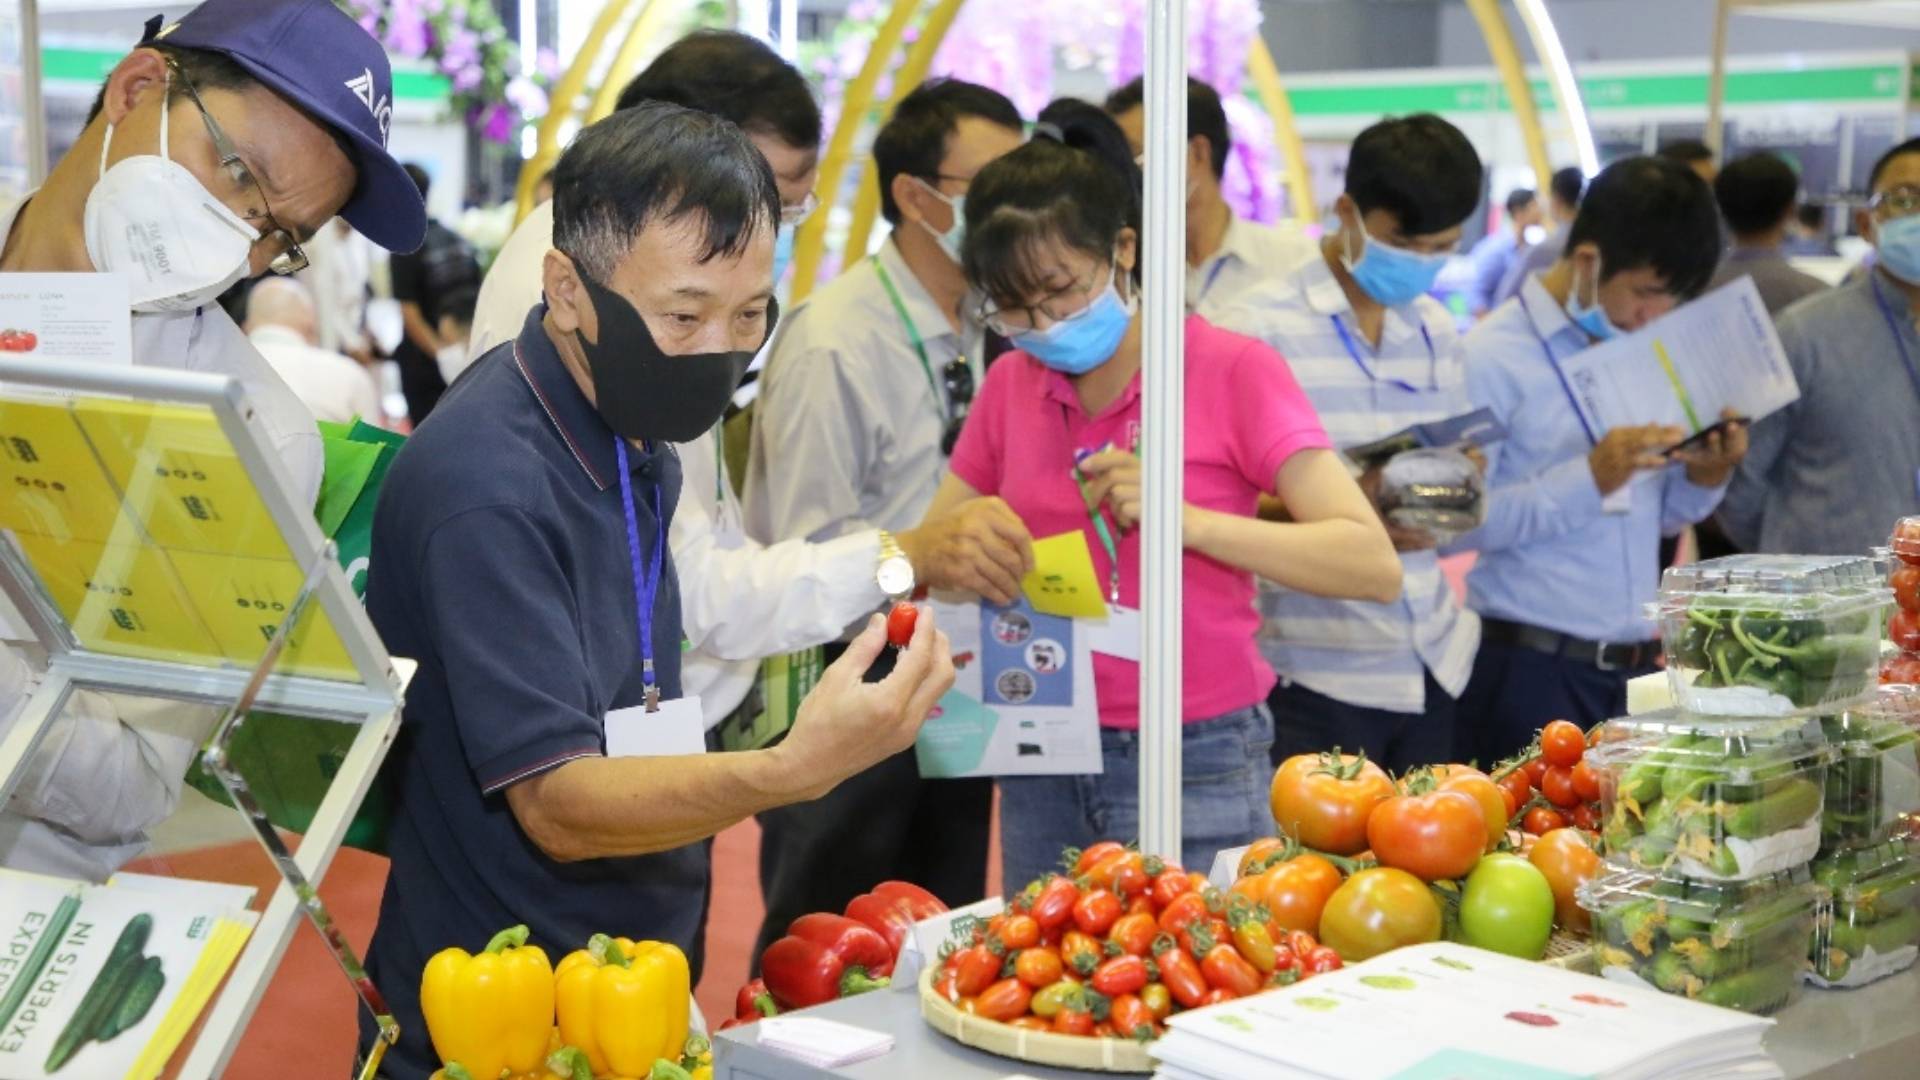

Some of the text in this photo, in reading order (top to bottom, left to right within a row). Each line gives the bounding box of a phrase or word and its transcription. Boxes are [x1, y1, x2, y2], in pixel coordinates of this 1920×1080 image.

[153, 244, 173, 275] 9001
[1, 921, 95, 1053] EXPERTS IN
